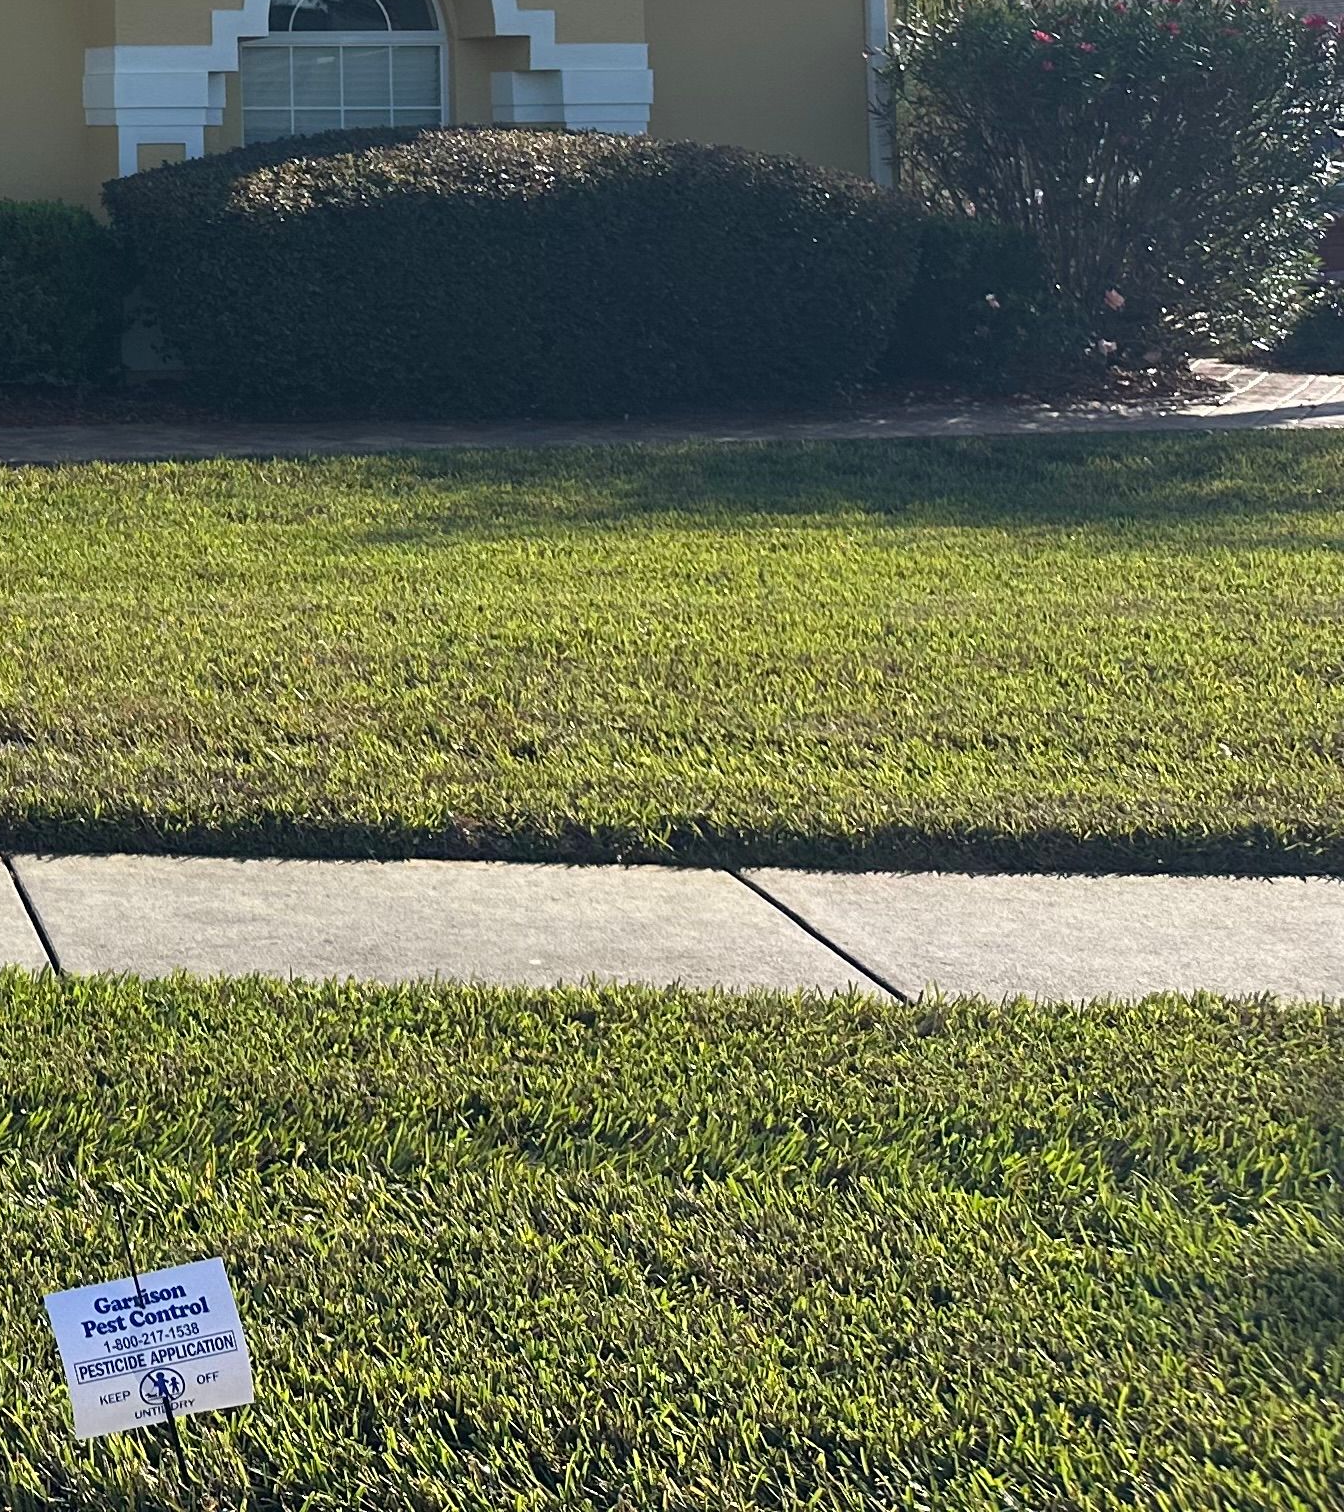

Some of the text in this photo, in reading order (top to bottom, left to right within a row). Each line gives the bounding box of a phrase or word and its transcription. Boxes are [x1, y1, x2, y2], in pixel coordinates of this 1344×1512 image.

[81, 1296, 210, 1338] Pest Control
[103, 1322, 200, 1353] 1-800-217-1538
[79, 1334, 234, 1380] PESTICIDE APPLICATION
[99, 1371, 219, 1405] KEEP OFF
[171, 1398, 195, 1411] DRY
